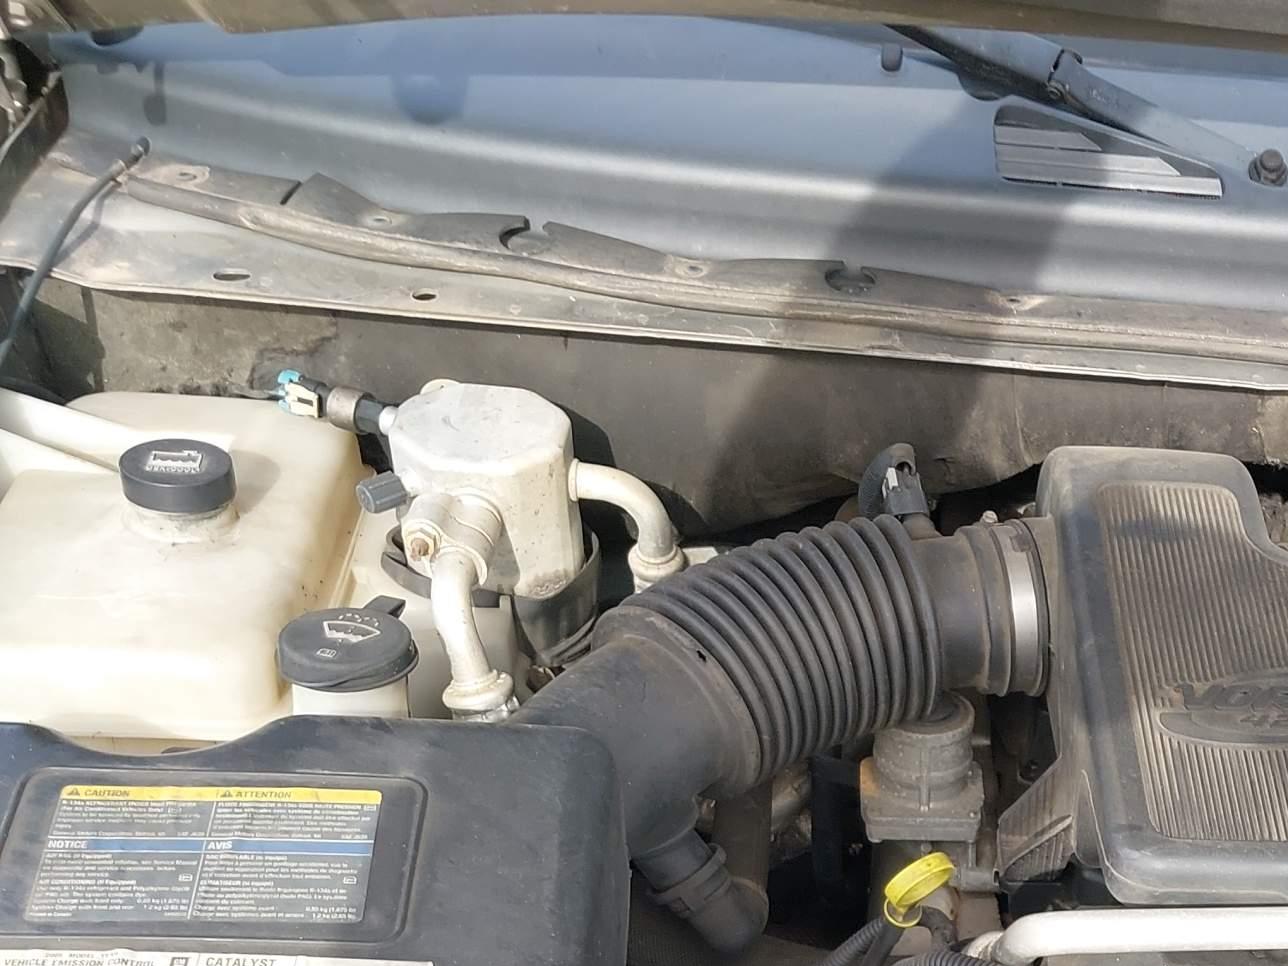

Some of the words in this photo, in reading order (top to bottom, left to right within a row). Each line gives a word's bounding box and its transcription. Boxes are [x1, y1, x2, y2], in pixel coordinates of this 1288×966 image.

[235, 791, 292, 799] ATTENTION
[47, 840, 88, 849] NOTICE
[207, 840, 233, 850] AVIS
[4, 958, 47, 966] VEHICLE
[52, 959, 105, 966] EMISSION
